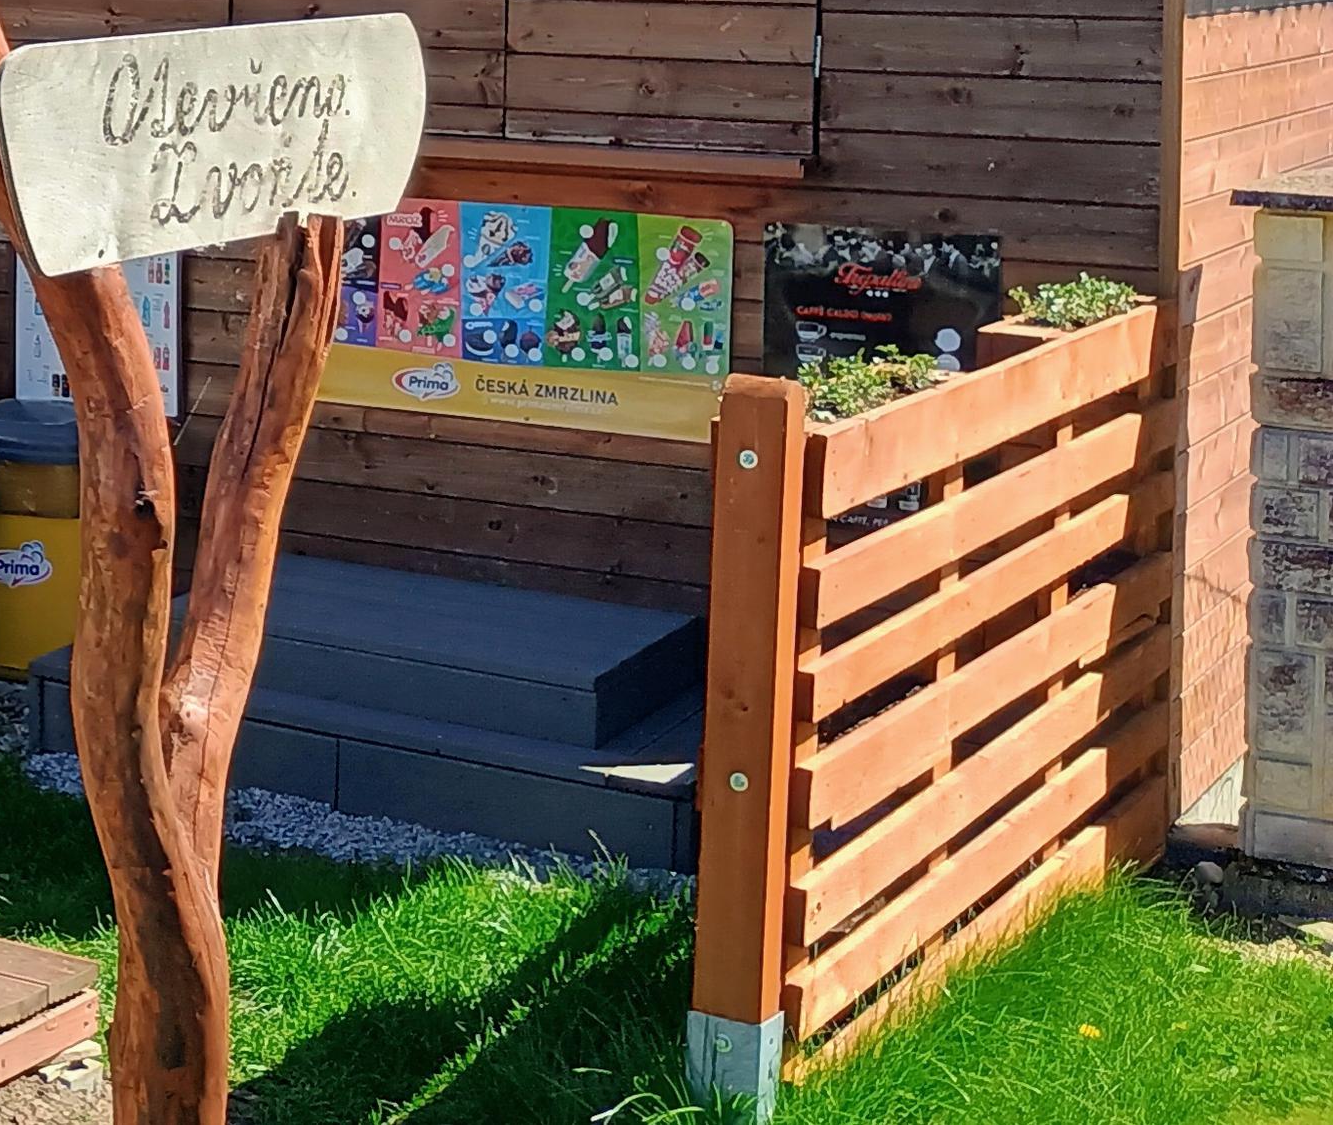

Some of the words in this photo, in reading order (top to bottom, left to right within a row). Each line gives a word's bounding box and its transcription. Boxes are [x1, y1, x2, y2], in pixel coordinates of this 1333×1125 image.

[408, 375, 449, 391] Prima
[475, 374, 530, 397] ČESKÁ
[534, 383, 619, 406] ZMRZLINA
